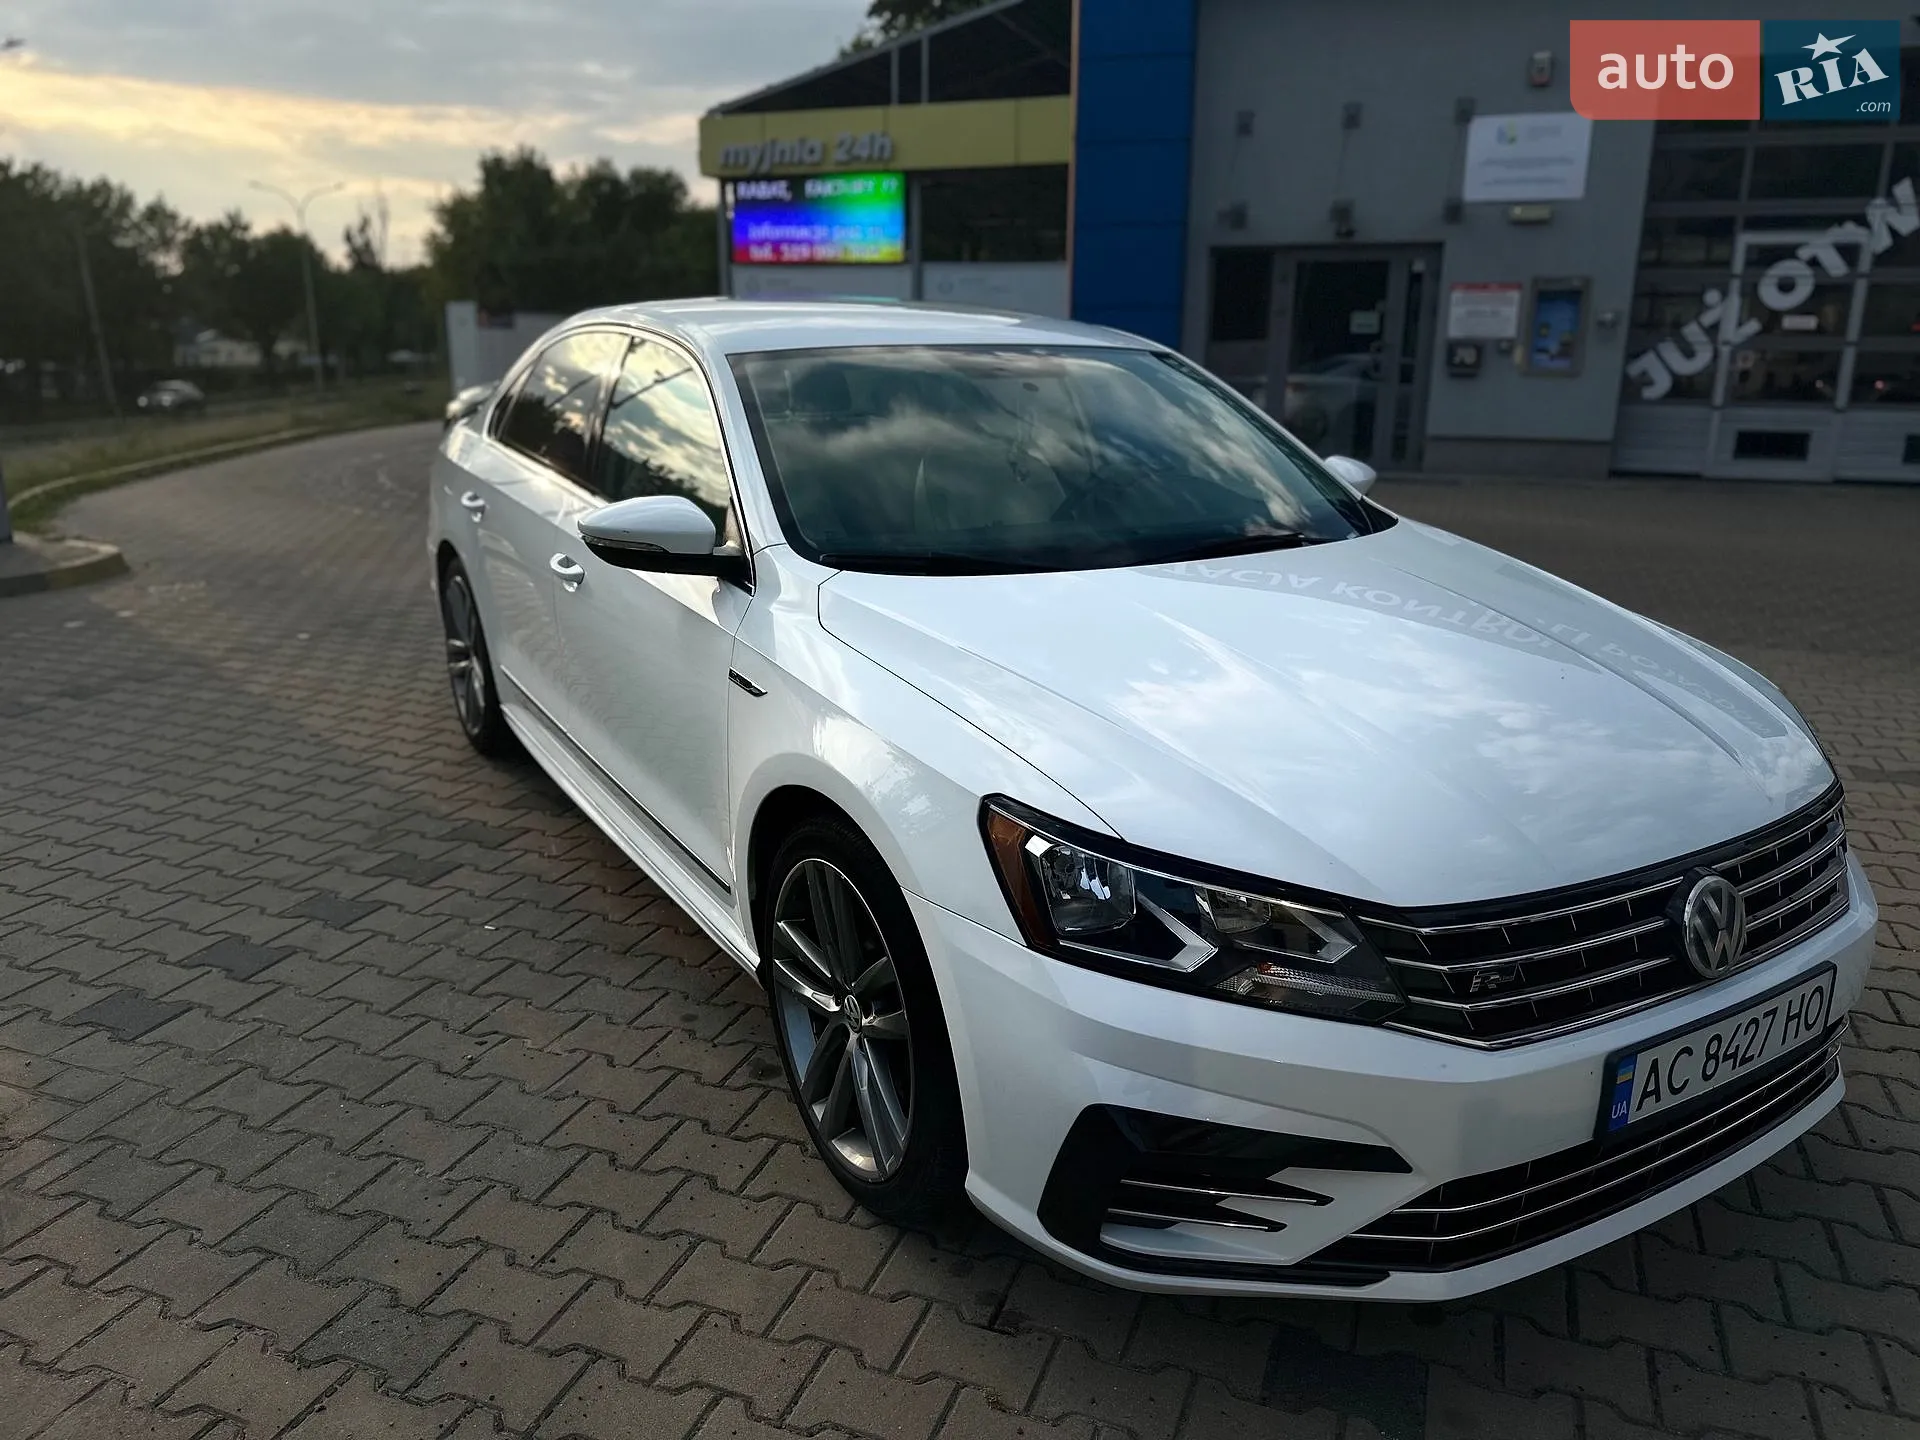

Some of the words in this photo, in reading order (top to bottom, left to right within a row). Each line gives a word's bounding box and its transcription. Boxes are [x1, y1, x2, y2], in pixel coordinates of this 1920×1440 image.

[721, 139, 823, 173] myjnia
[834, 131, 893, 162] 24h
[1625, 287, 1763, 400] JUŻ
[1635, 1046, 1694, 1112] AC
[1701, 1006, 1778, 1082] 8427
[1781, 985, 1824, 1046] HO
[1611, 1100, 1628, 1119] UA
